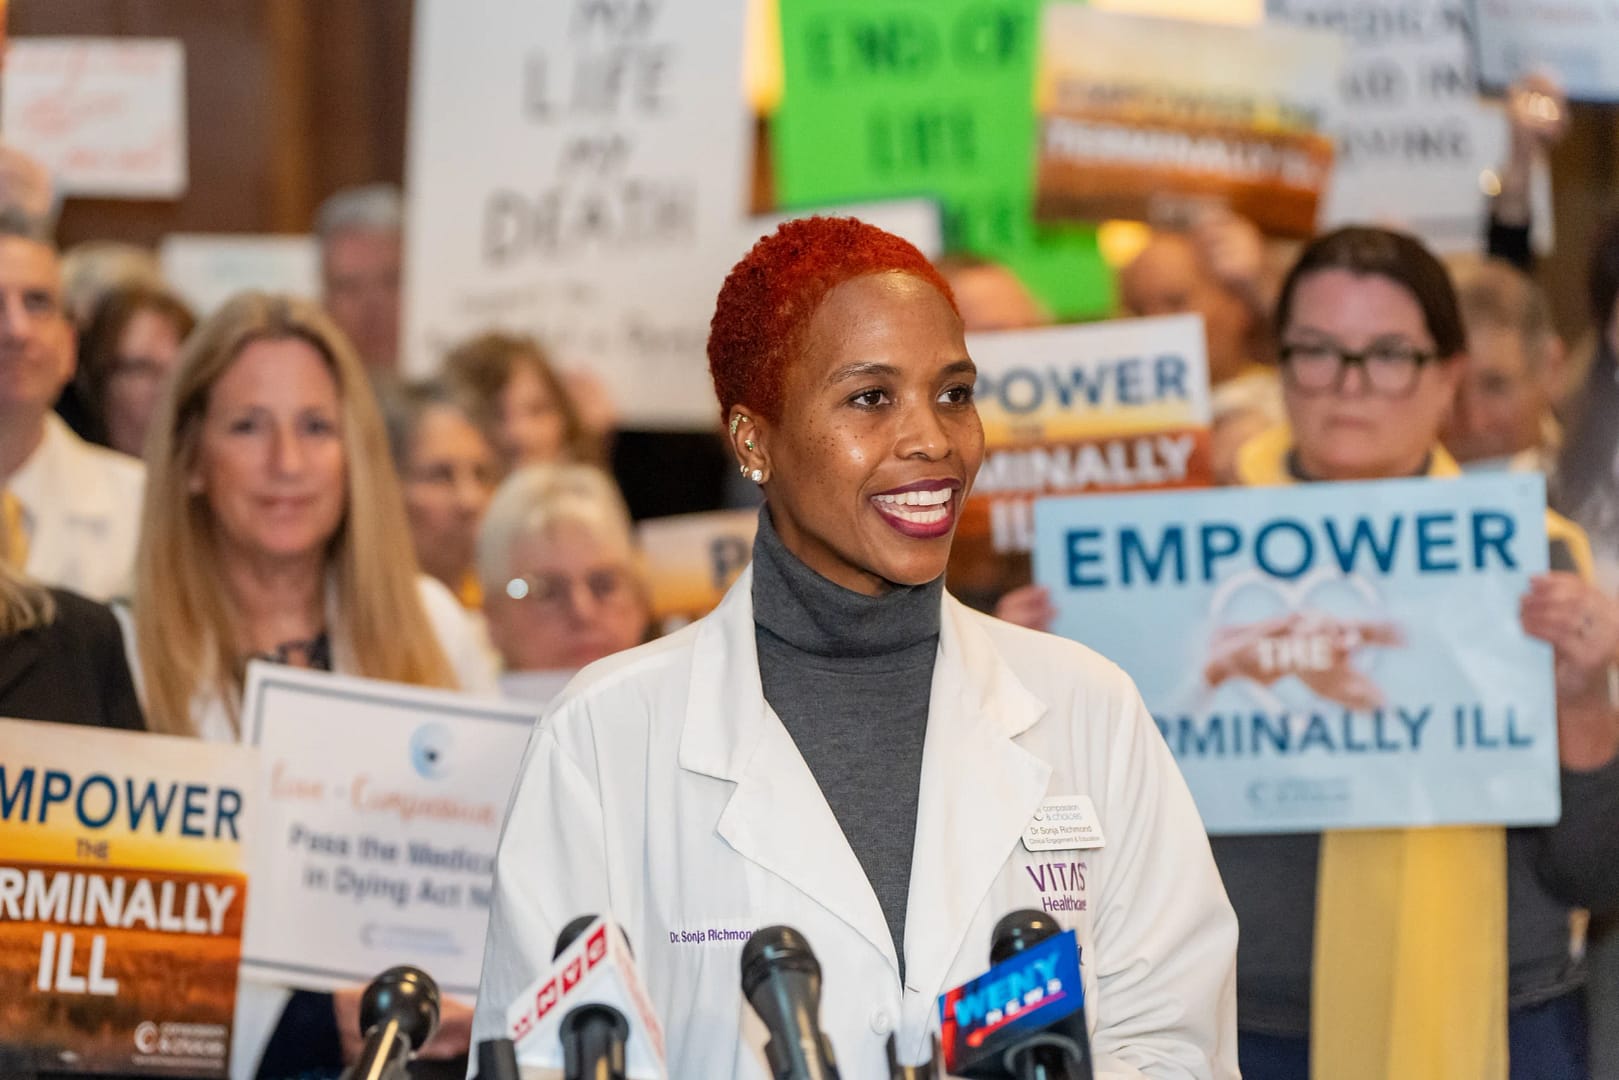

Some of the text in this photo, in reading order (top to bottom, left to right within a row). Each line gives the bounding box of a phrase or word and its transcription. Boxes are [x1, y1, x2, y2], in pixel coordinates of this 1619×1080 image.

[521, 44, 676, 124] LIFE
[482, 176, 700, 266] DEATH
[1064, 509, 1520, 589] EMPOWER
[1256, 632, 1333, 672] THE
[1455, 704, 1535, 750] ILL
[0, 763, 244, 842] MPOWER
[1060, 824, 1093, 834] Richmond
[0, 867, 236, 936] RMINALLY
[681, 929, 706, 945] Sonja
[708, 927, 754, 942] Richmon
[37, 931, 120, 996] ILL
[953, 952, 1060, 1028] WENY
